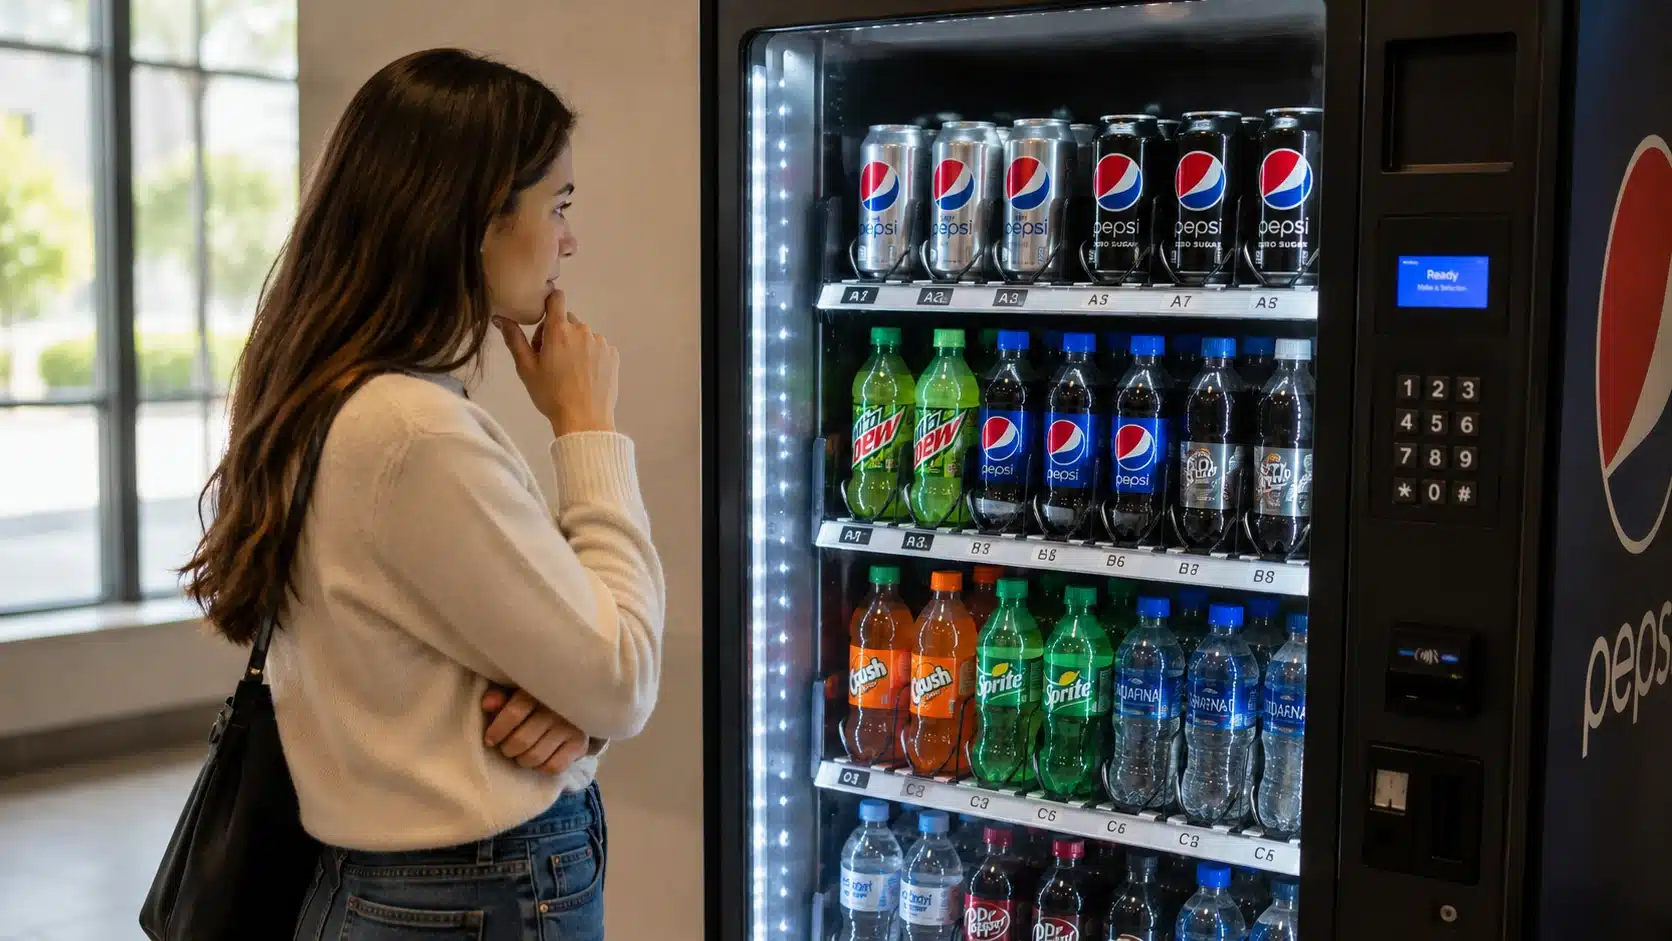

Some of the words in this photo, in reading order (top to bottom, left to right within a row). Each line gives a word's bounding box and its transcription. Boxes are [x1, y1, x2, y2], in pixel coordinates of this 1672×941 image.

[1092, 219, 1140, 238] pepsi
[1174, 218, 1222, 238] pepsi
[1258, 217, 1309, 238] pepsi
[1427, 269, 1460, 282] Ready
[1170, 295, 1192, 307] A7
[1404, 379, 1413, 397] 1
[1432, 380, 1444, 398] 2
[1462, 381, 1474, 399] 3
[1401, 413, 1413, 430] 4
[1431, 415, 1442, 432] 5
[1461, 416, 1473, 433] 6
[1401, 447, 1412, 464] 7
[1429, 449, 1441, 466] 8
[1460, 450, 1472, 467] 9
[981, 464, 1014, 477] pepsi
[1046, 469, 1079, 482] pepsi
[1115, 473, 1149, 488] pepsi
[1428, 484, 1440, 500] 0
[1458, 485, 1471, 502] #
[1106, 555, 1126, 568] B6
[1253, 569, 1274, 584] B8
[977, 670, 1023, 701] Sprite
[1581, 600, 1672, 758] peps
[1045, 679, 1091, 711] Sprite
[1107, 820, 1127, 834] C6
